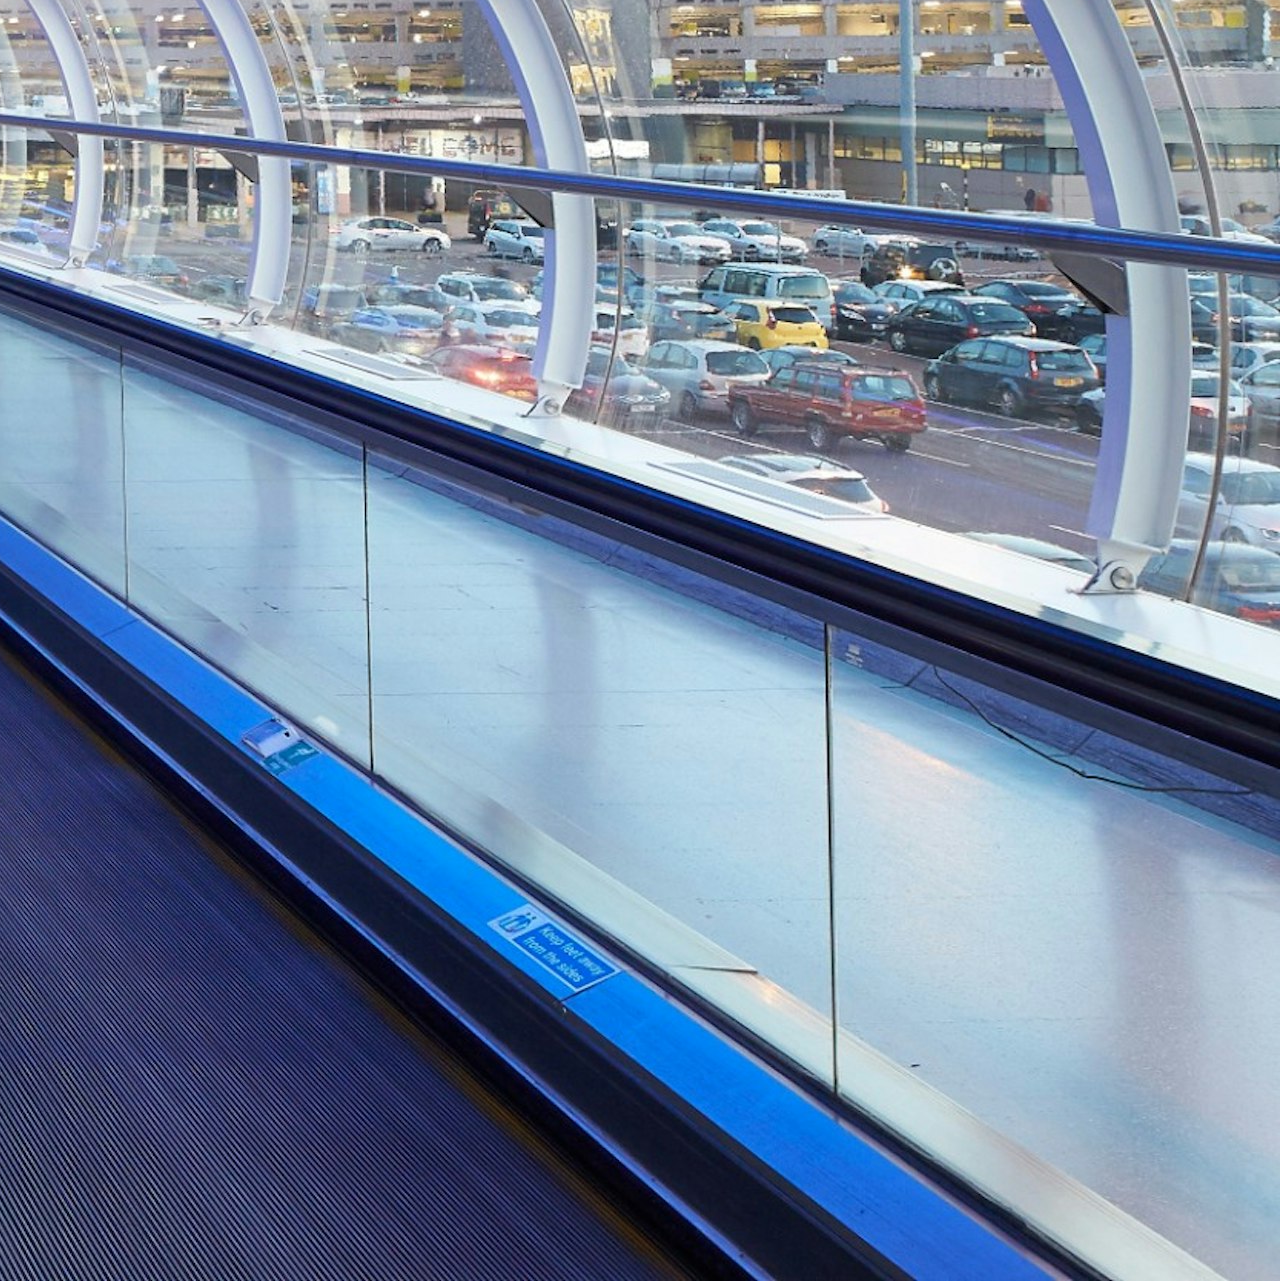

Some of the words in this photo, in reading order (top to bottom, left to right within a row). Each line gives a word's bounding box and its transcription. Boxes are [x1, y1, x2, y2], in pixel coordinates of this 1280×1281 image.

[522, 936, 547, 955] from
[542, 951, 561, 965] the
[556, 963, 584, 983] sides
[539, 925, 565, 946] Keep
[560, 942, 584, 959] feet
[577, 956, 606, 975] away
